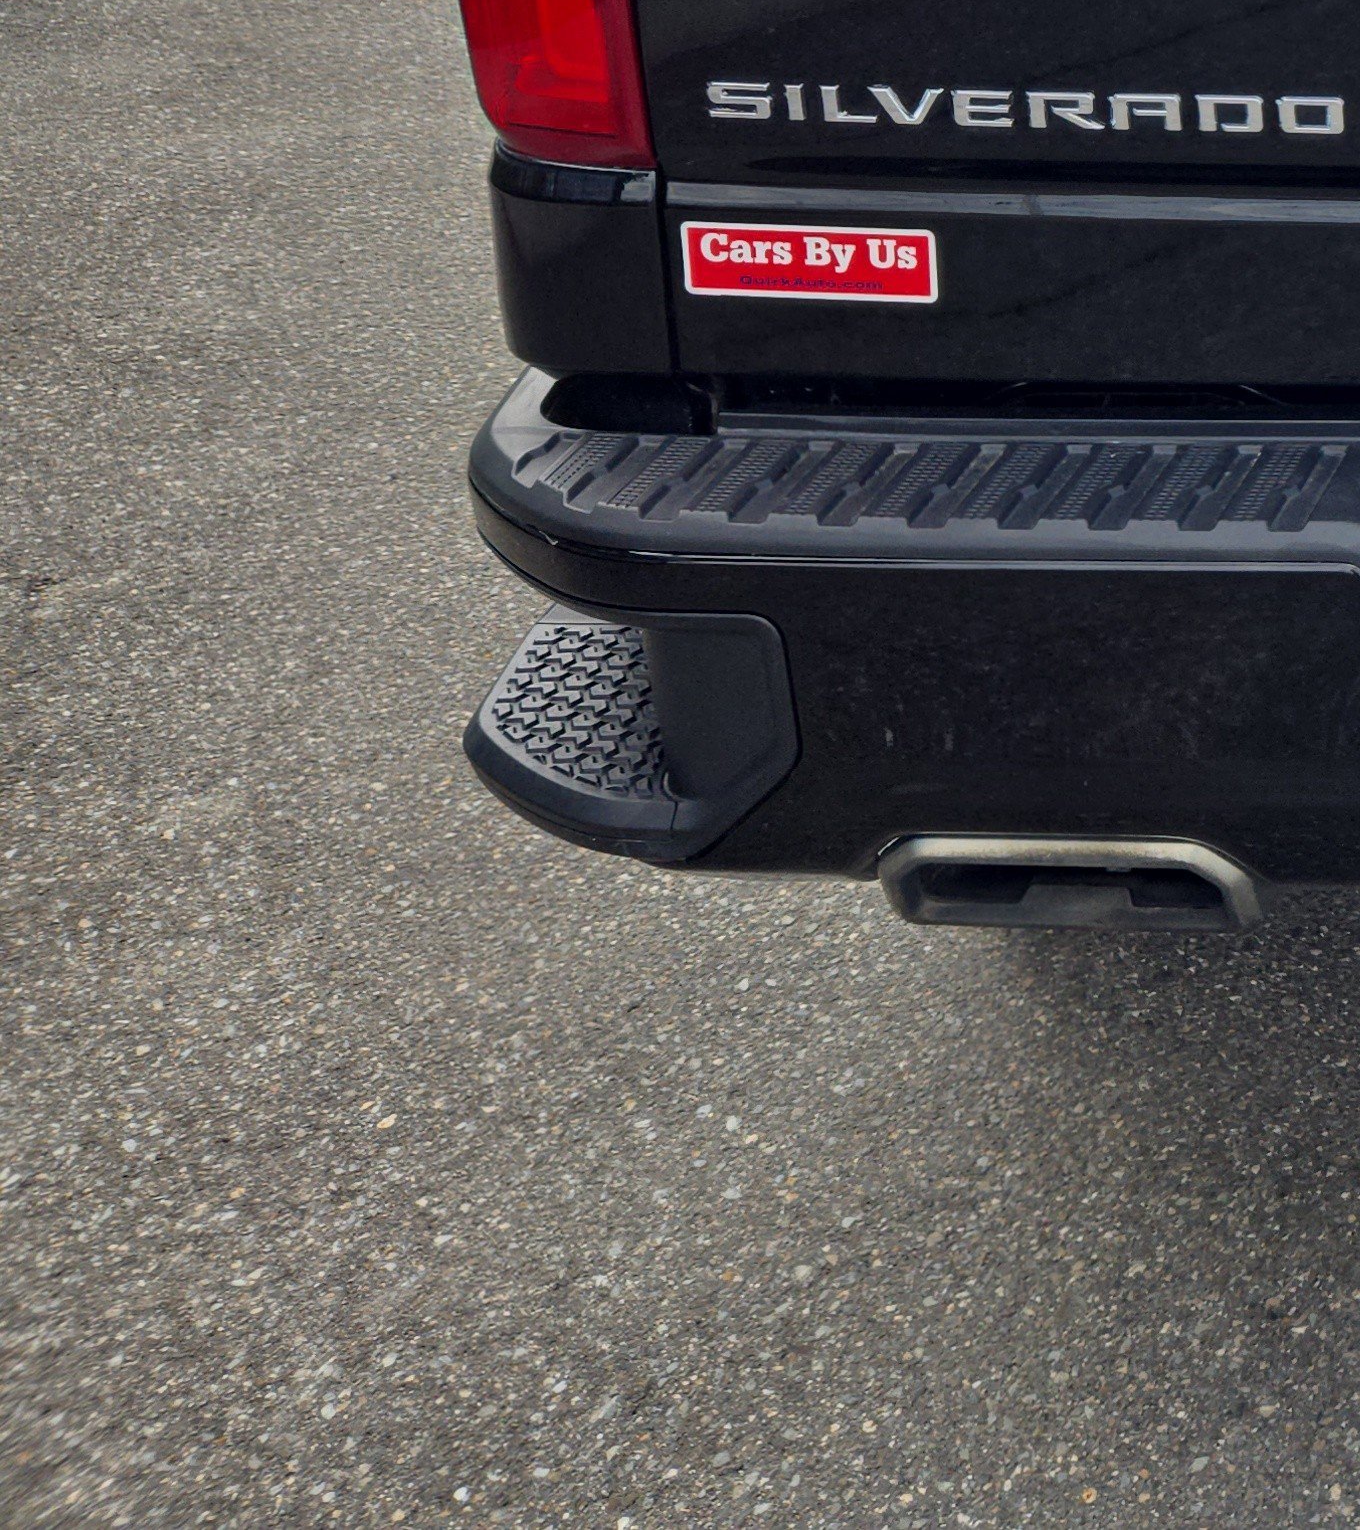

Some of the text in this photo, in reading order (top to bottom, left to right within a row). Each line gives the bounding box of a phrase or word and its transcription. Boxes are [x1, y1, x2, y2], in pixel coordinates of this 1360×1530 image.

[706, 81, 1345, 135] SILVERADO
[700, 233, 918, 273] Cars By Us
